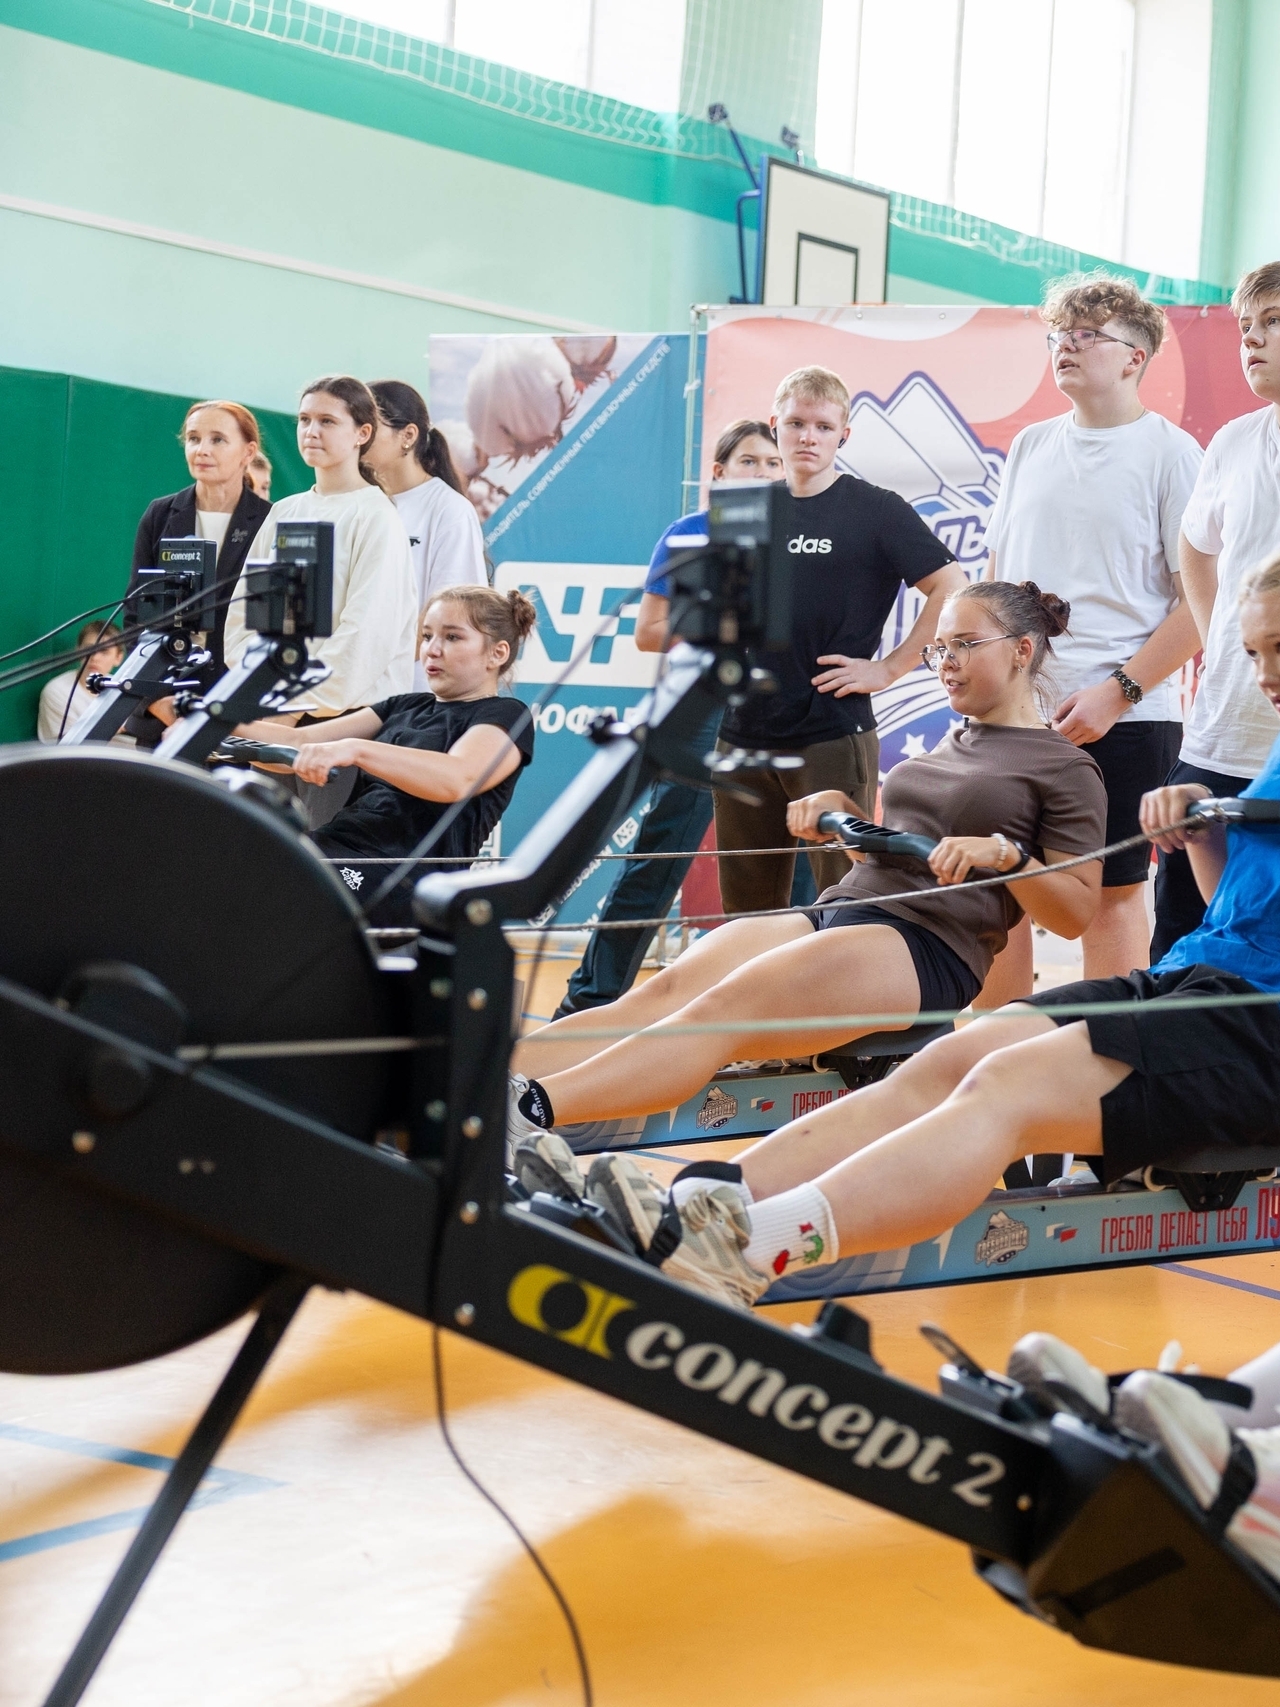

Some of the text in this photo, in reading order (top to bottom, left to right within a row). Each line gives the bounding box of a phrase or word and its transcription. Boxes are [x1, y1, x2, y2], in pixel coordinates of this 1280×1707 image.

[526, 440, 583, 502] СОВРЕМЕННЫХ
[579, 379, 639, 445] ПЕРЕВЯЗОЧНЫХ
[635, 342, 671, 383] СРЕДСТВ
[171, 551, 201, 562] concept 2
[787, 534, 833, 554] das
[1101, 1214, 1153, 1253] ГРЕБЛЯ
[1158, 1212, 1208, 1252] ДЕЛАЕТ
[1216, 1207, 1247, 1244] ТЕБЯ
[626, 1321, 1007, 1507] concept 2
